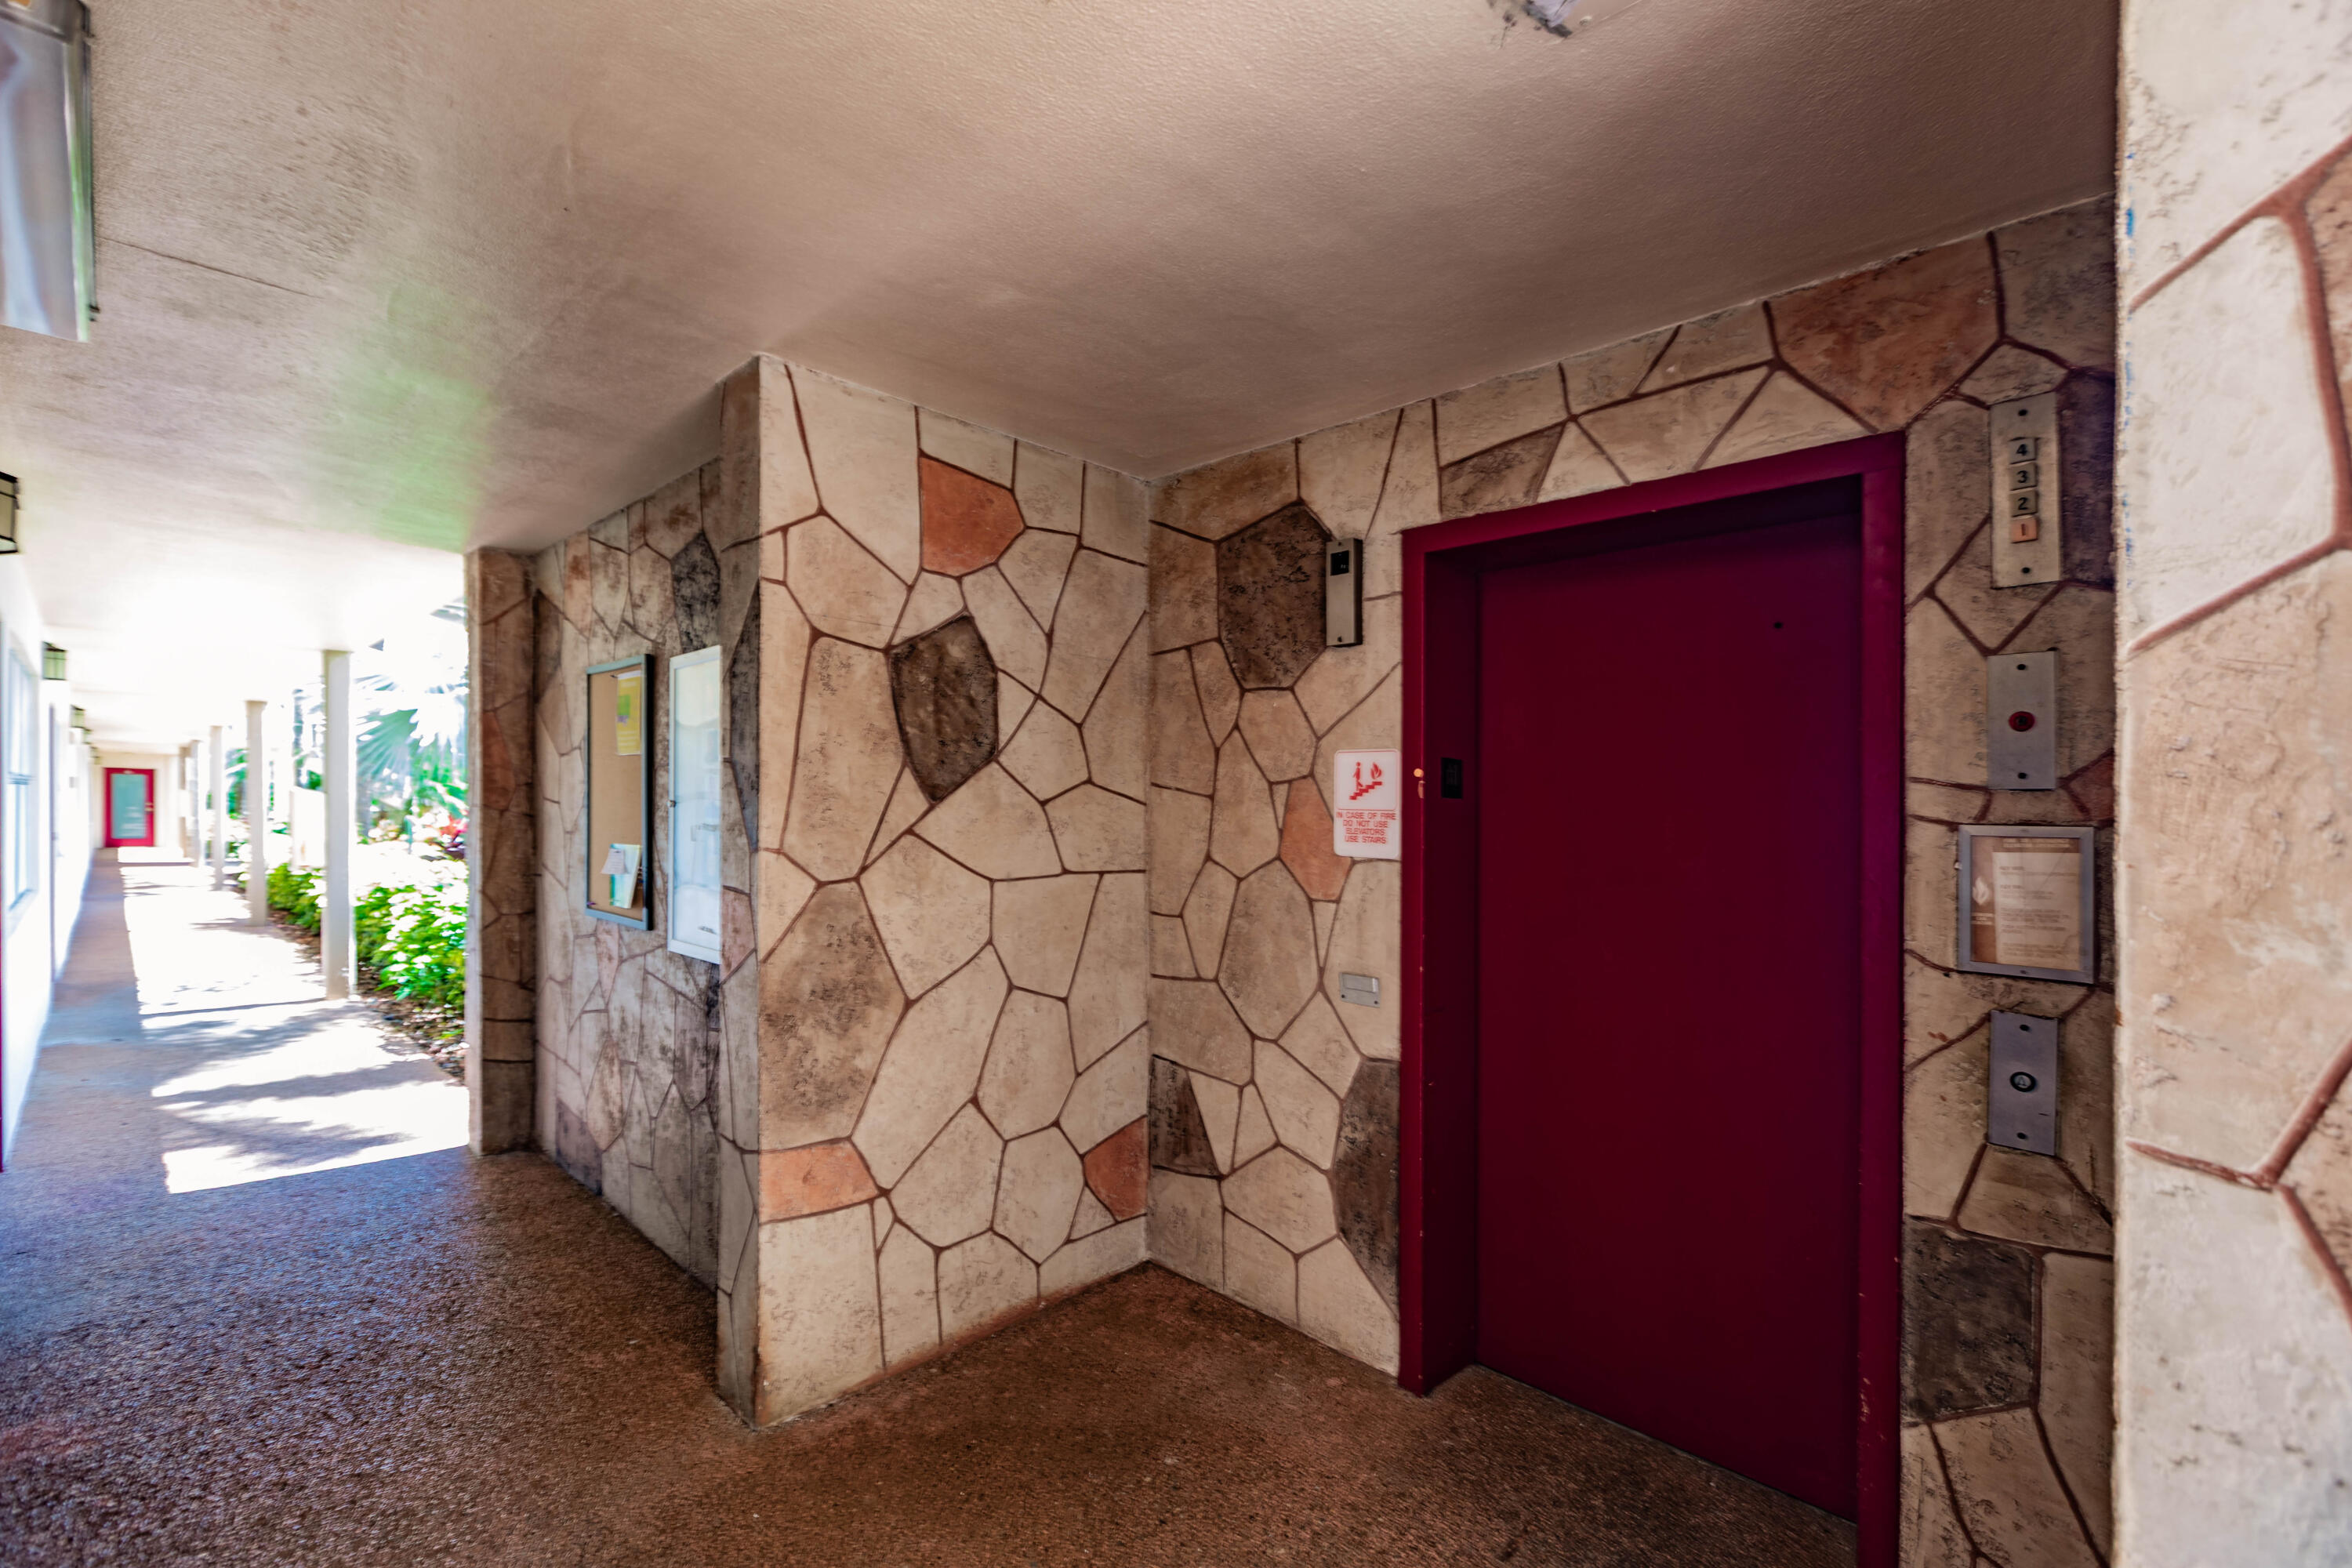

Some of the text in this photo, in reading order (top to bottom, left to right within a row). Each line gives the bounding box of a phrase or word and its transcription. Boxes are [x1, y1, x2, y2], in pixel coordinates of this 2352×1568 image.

[2016, 444, 2028, 456] 4
[2016, 470, 2028, 484] 3
[2017, 497, 2029, 510] 2
[2021, 523, 2027, 536] 1
[1345, 827, 1386, 837] ELEVATORS
[1362, 836, 1387, 844] STAIRS
